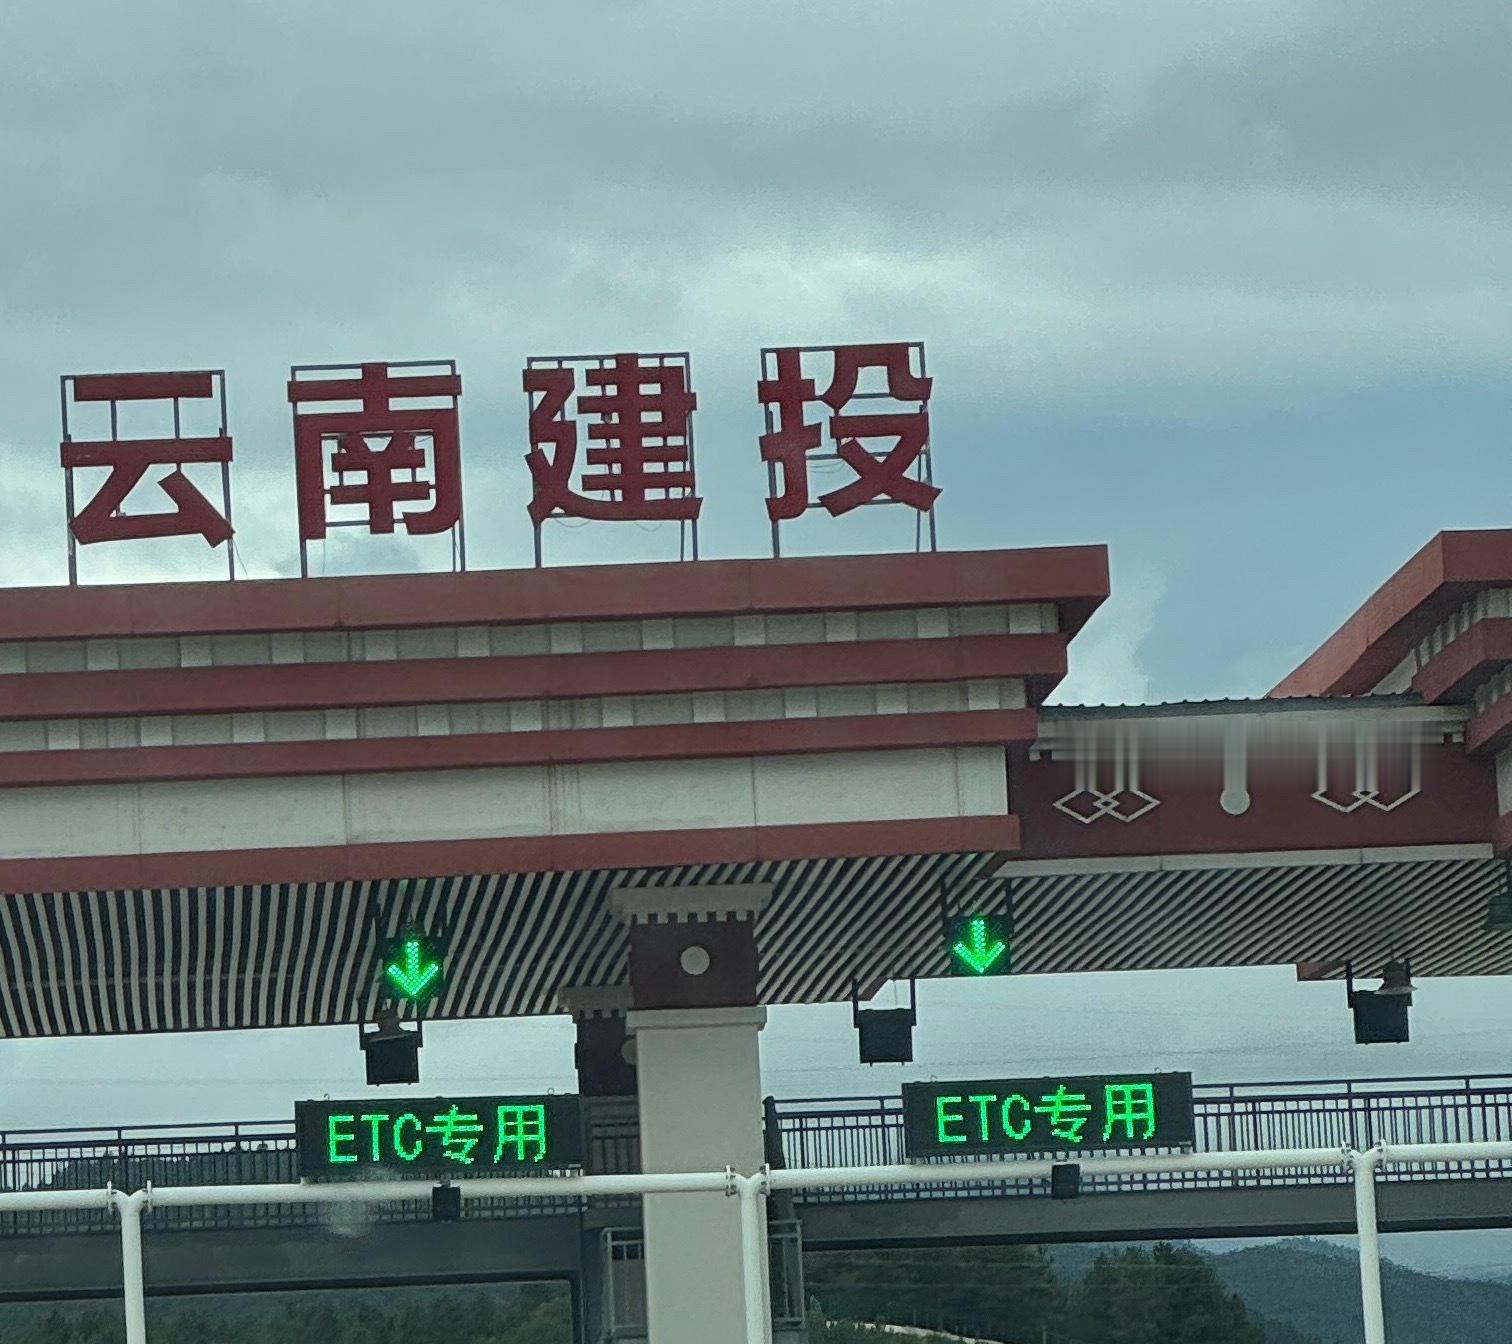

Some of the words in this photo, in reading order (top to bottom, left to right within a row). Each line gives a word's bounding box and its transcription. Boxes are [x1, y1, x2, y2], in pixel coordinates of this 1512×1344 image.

[59, 342, 944, 549] 云南建投
[328, 1103, 547, 1165] ETC专用
[936, 1083, 1156, 1144] ETC专用
